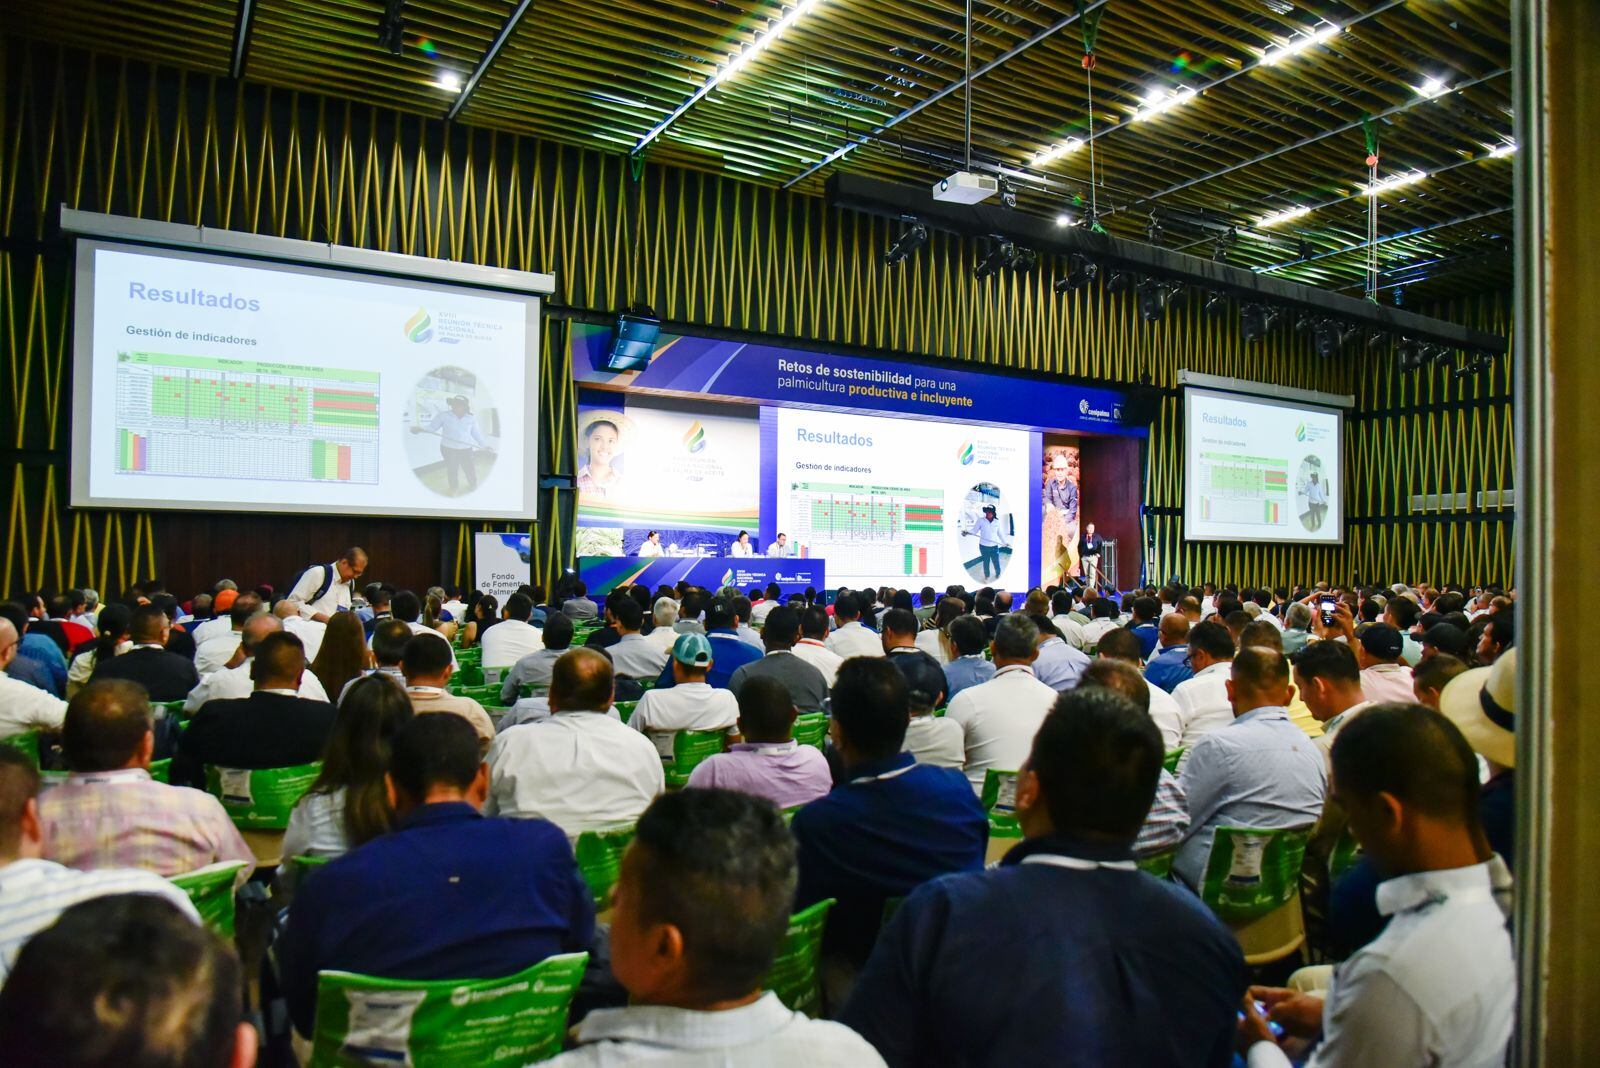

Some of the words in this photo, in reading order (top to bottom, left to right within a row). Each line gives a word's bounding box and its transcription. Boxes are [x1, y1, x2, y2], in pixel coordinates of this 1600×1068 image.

[129, 281, 260, 312] Resultados
[126, 325, 172, 339] Gestión
[175, 329, 189, 340] de
[192, 331, 257, 346] indicadores
[778, 358, 813, 374] Retos
[815, 363, 830, 377] de
[833, 366, 912, 386] sostenibilidad
[914, 377, 936, 390] para
[938, 379, 957, 392] una
[777, 375, 846, 393] palmicultura
[848, 384, 908, 401] productiva
[910, 391, 918, 401] e
[920, 390, 973, 408] incluyente
[1202, 412, 1247, 428] Resultados
[797, 428, 873, 447] Resultados
[823, 463, 833, 471] de
[833, 463, 872, 474] indicadores
[491, 572, 515, 580] Fondo
